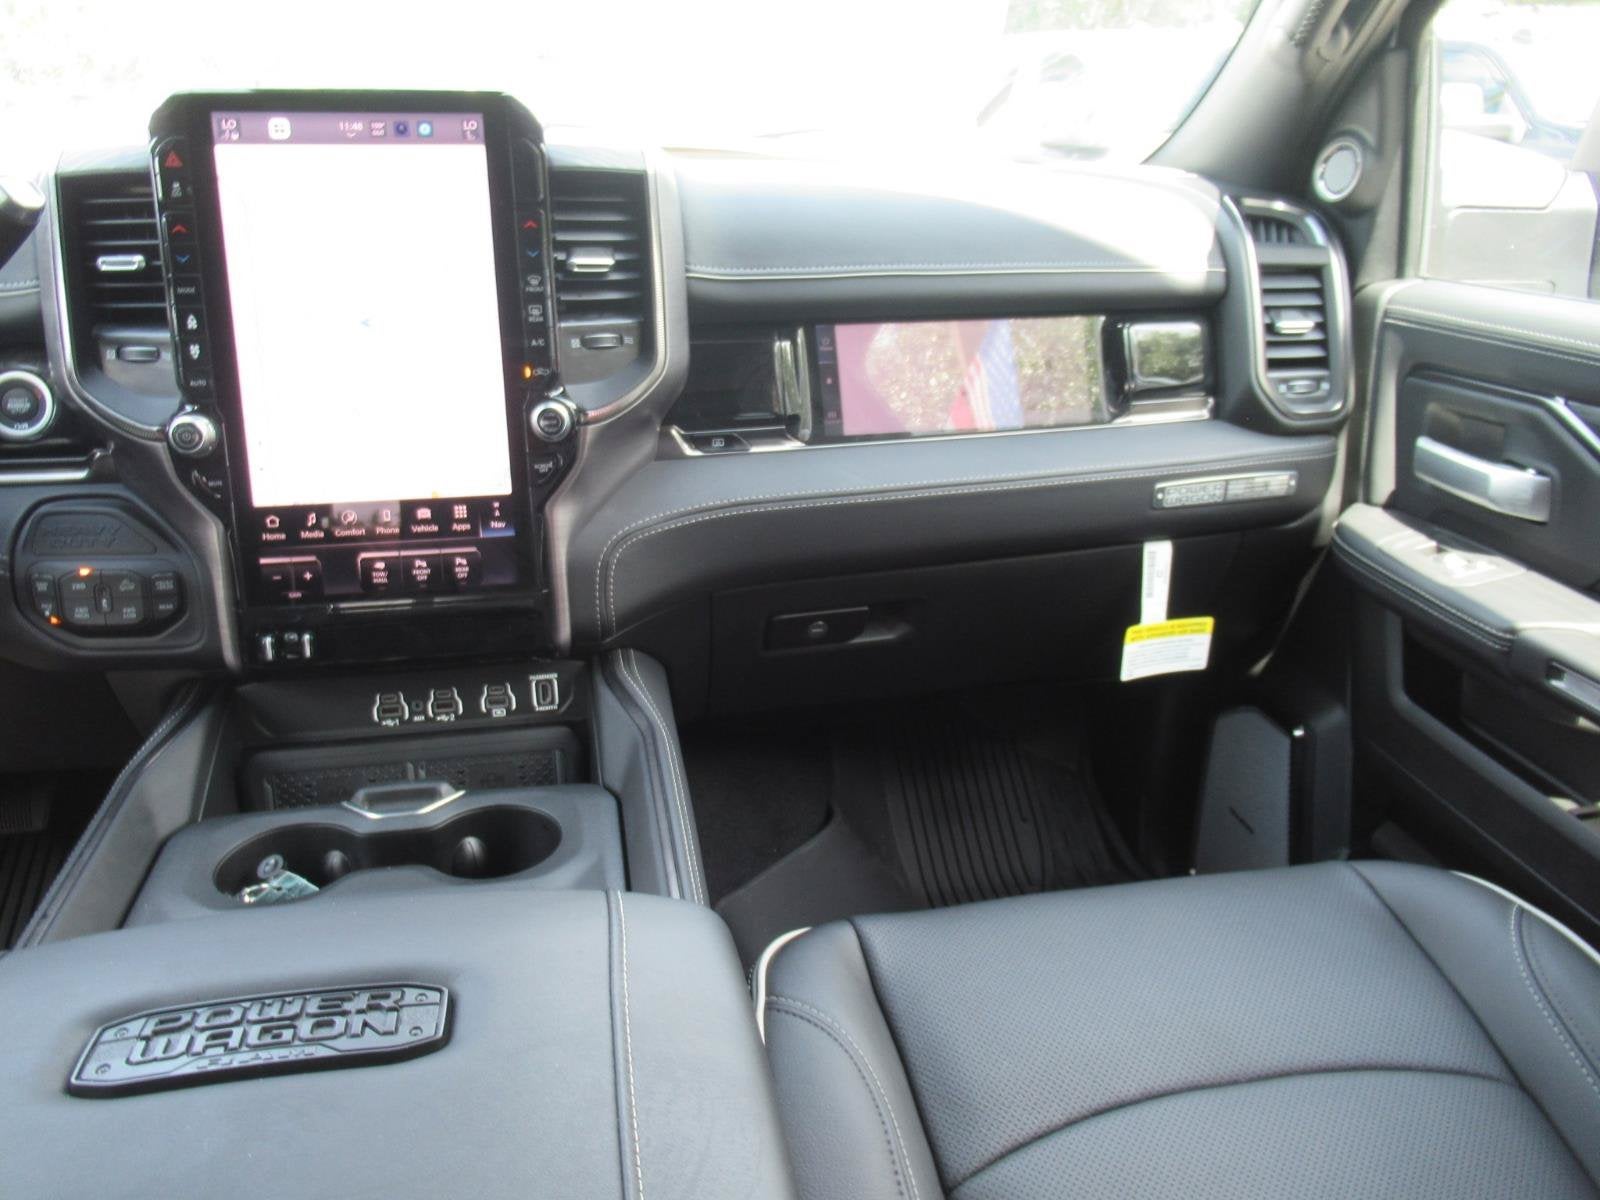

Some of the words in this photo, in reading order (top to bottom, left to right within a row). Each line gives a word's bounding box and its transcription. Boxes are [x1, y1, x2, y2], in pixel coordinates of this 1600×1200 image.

[462, 120, 478, 130] LO
[189, 379, 207, 387] AUTO
[411, 523, 439, 533] Vehicle
[452, 522, 471, 532] Apps
[490, 520, 507, 529] Nav
[301, 529, 325, 539] Media
[335, 527, 366, 537] Comfort
[376, 526, 399, 535] Phone
[262, 532, 287, 541] Home
[140, 988, 406, 1037] POWER
[125, 1009, 399, 1065] WAGON
